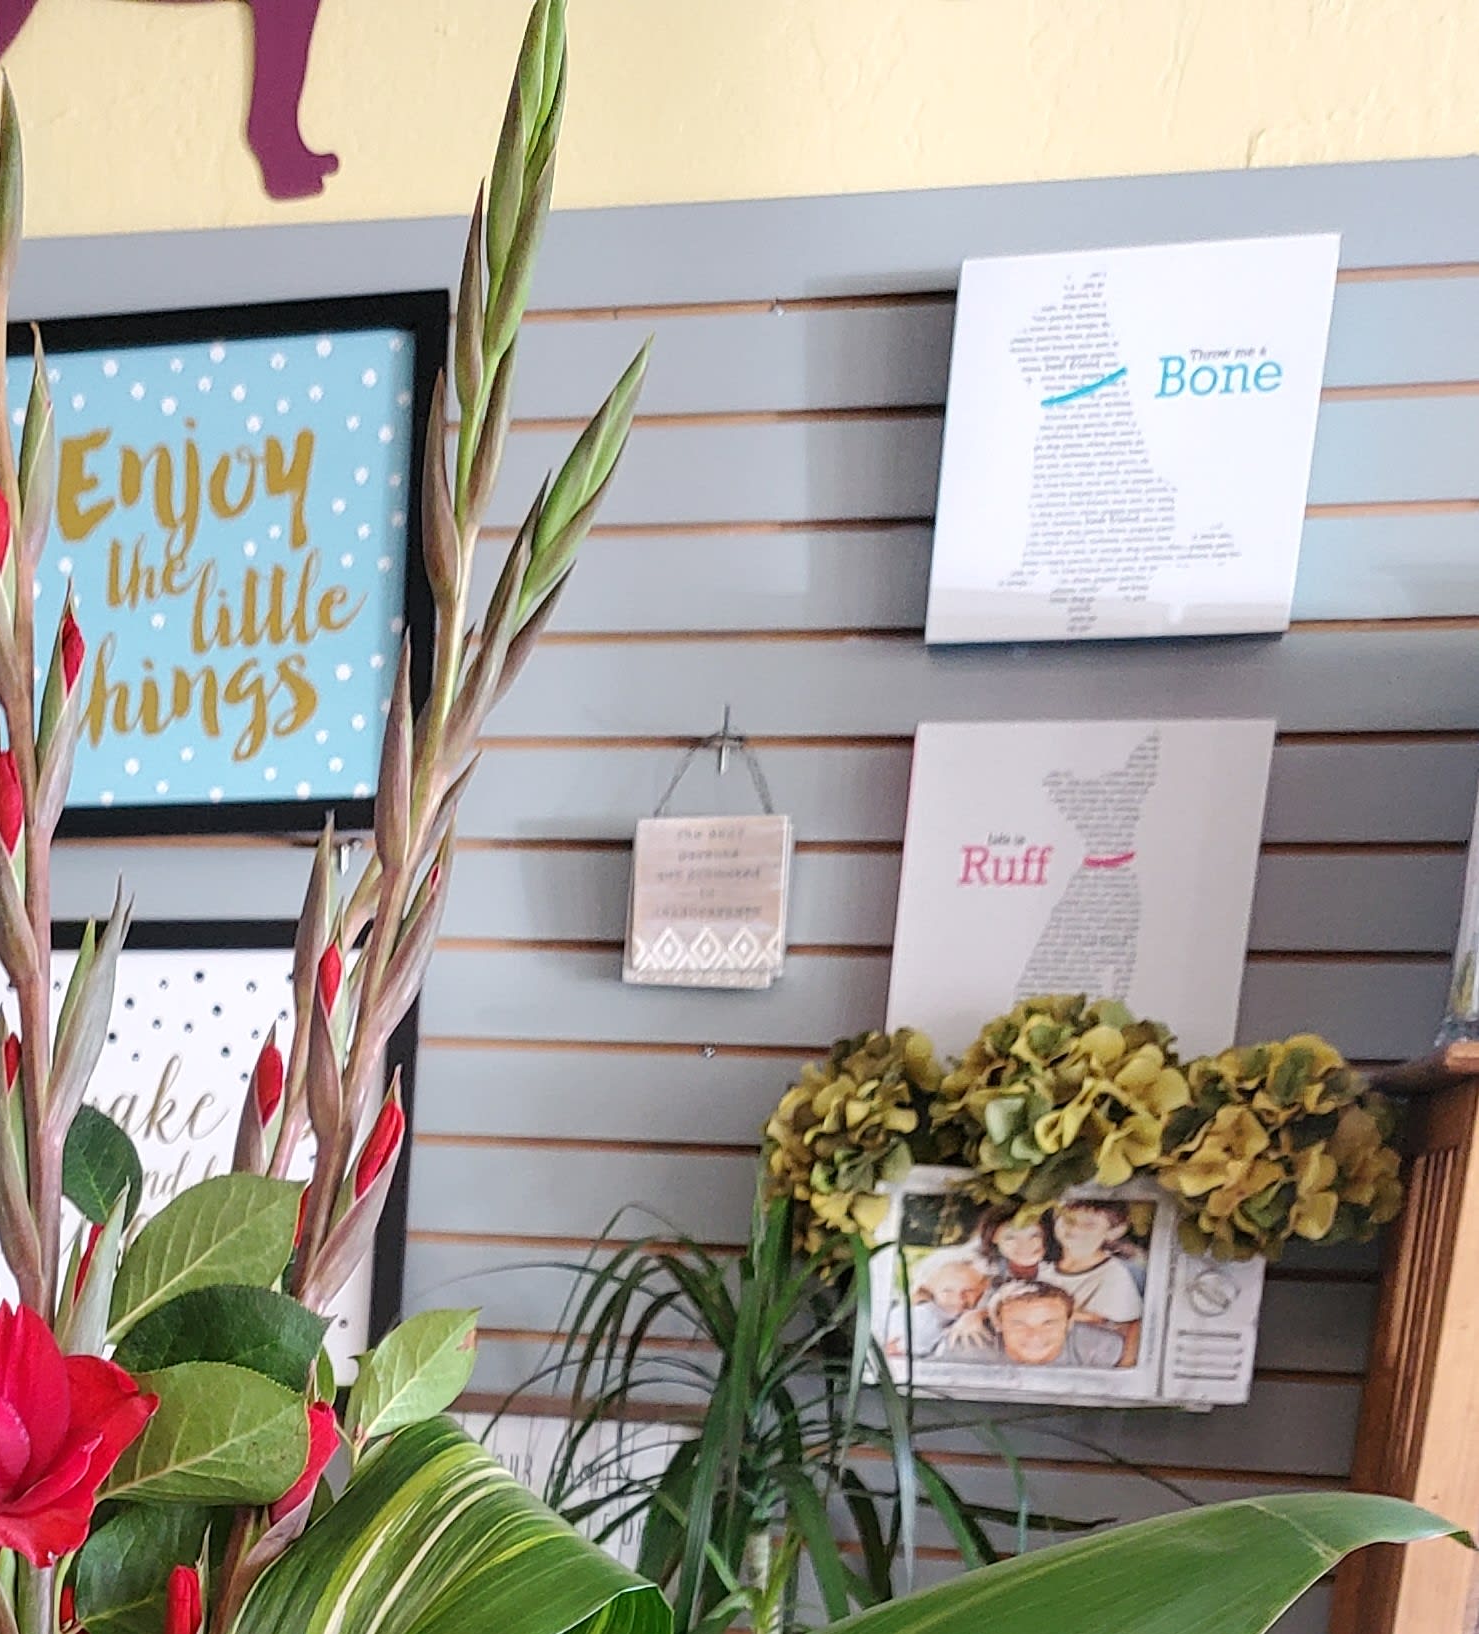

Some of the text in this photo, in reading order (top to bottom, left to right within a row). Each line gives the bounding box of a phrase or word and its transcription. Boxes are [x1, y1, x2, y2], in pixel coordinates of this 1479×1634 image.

[1154, 355, 1283, 399] Bone
[56, 416, 316, 558] Enjoy
[107, 532, 212, 608] the
[190, 547, 369, 655] little
[75, 632, 319, 763] hings
[958, 845, 1054, 887] Ruff
[90, 1053, 231, 1146] ake
